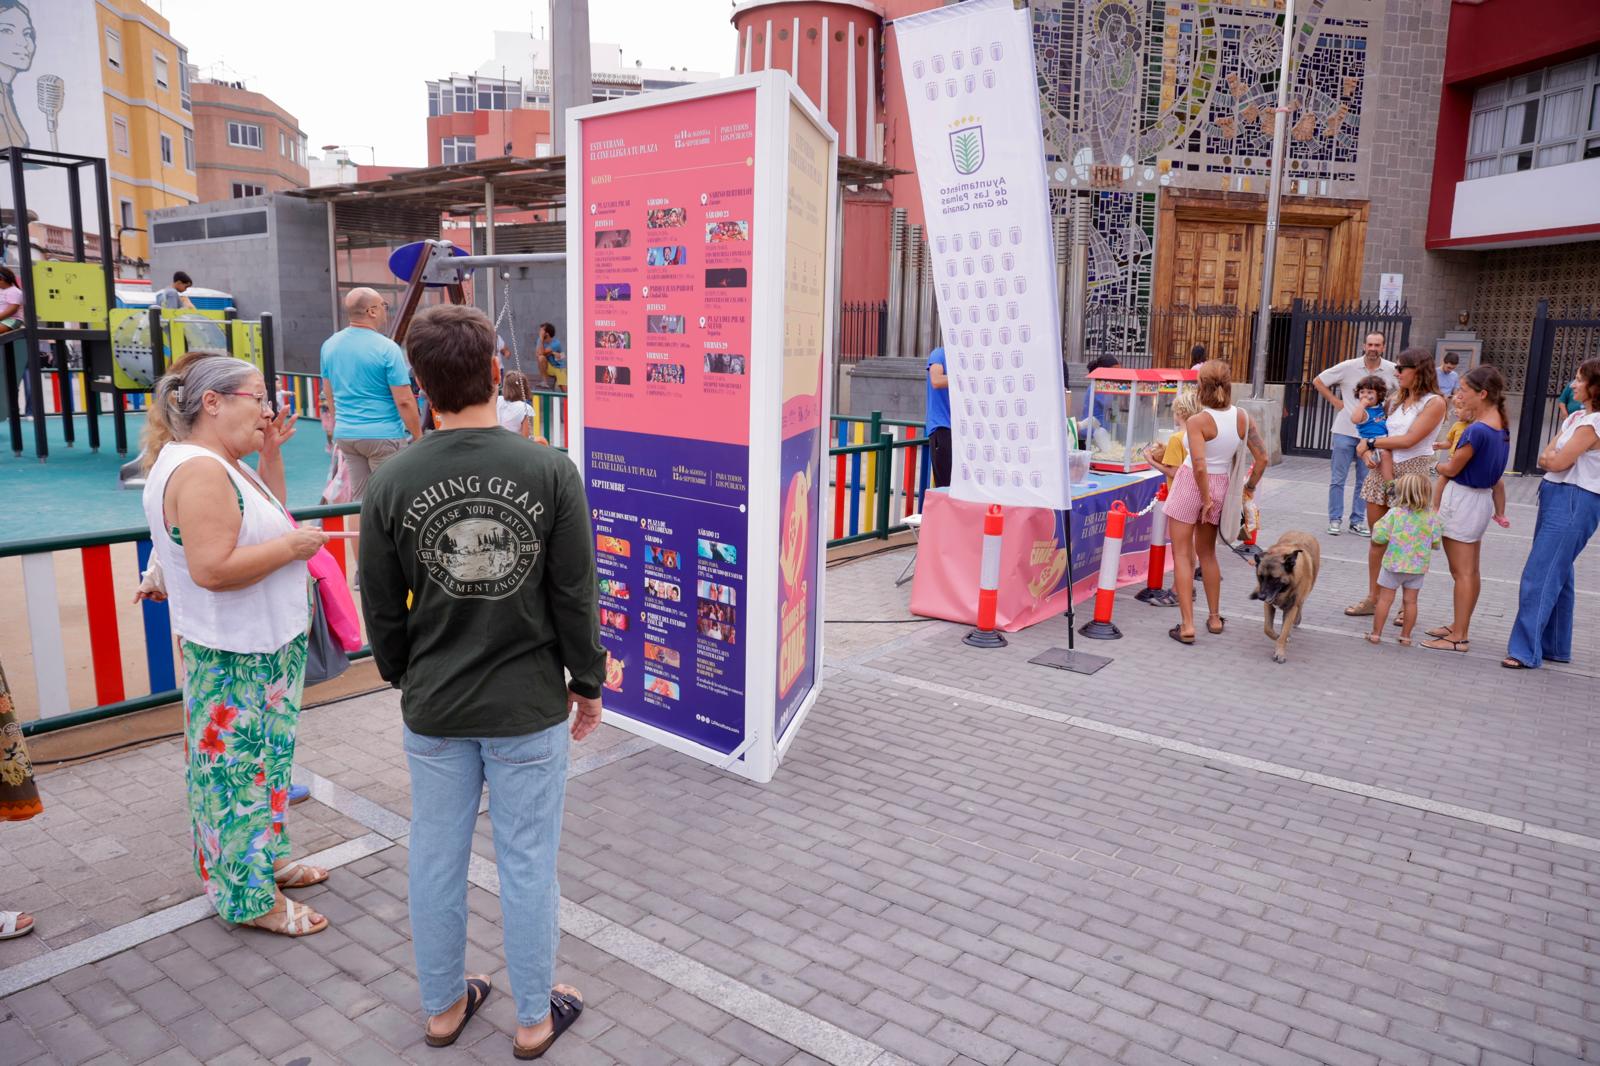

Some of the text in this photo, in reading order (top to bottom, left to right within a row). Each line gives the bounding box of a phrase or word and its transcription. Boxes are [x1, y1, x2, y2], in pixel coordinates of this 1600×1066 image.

[597, 151, 609, 160] CINE
[610, 149, 625, 158] LLEGA
[640, 144, 658, 154] PLAZA
[591, 175, 612, 185] AGOSTO
[592, 450, 626, 464] ESTE VERANO,
[592, 460, 597, 468] EL
[598, 461, 610, 470] CINE
[610, 463, 626, 473] LLEGA
[632, 466, 639, 475] TU
[639, 467, 657, 478] PLAZA
[715, 472, 743, 483] PARA TODOS
[715, 480, 723, 488] LOS
[591, 478, 626, 493] SEPTIEMBRE
[403, 475, 544, 532] FISHING GEAR
[599, 509, 611, 518] PLAZA
[424, 505, 530, 546] RELEASE YOUR CATCH
[697, 528, 714, 538] SÁBADO
[520, 542, 539, 552] 2019
[494, 557, 530, 593] ANGLER
